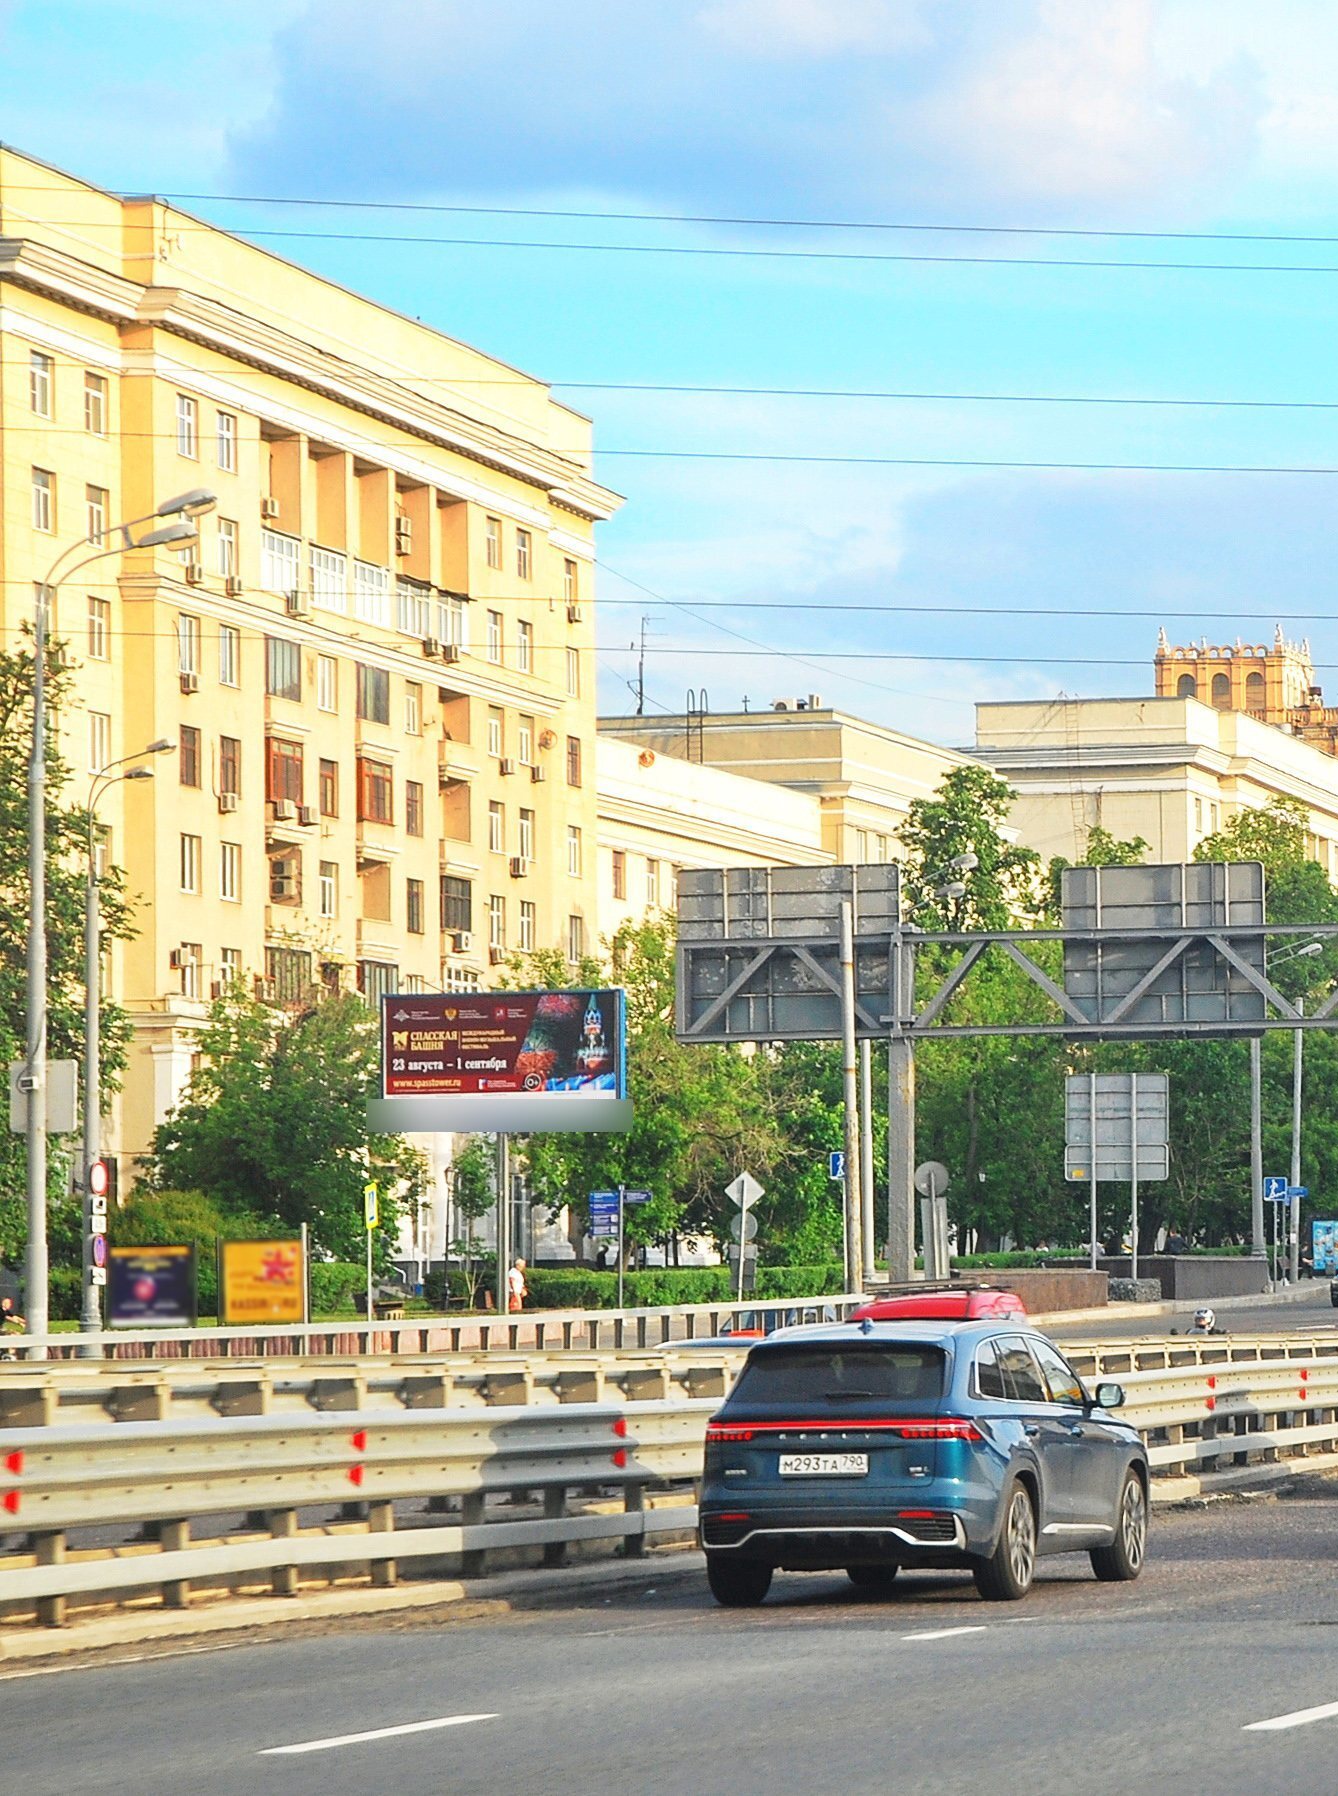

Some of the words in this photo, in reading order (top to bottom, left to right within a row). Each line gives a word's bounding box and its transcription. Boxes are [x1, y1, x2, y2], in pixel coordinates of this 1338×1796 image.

[392, 1058, 405, 1071] 23
[408, 1060, 443, 1073] августа
[465, 1057, 507, 1072] сентября
